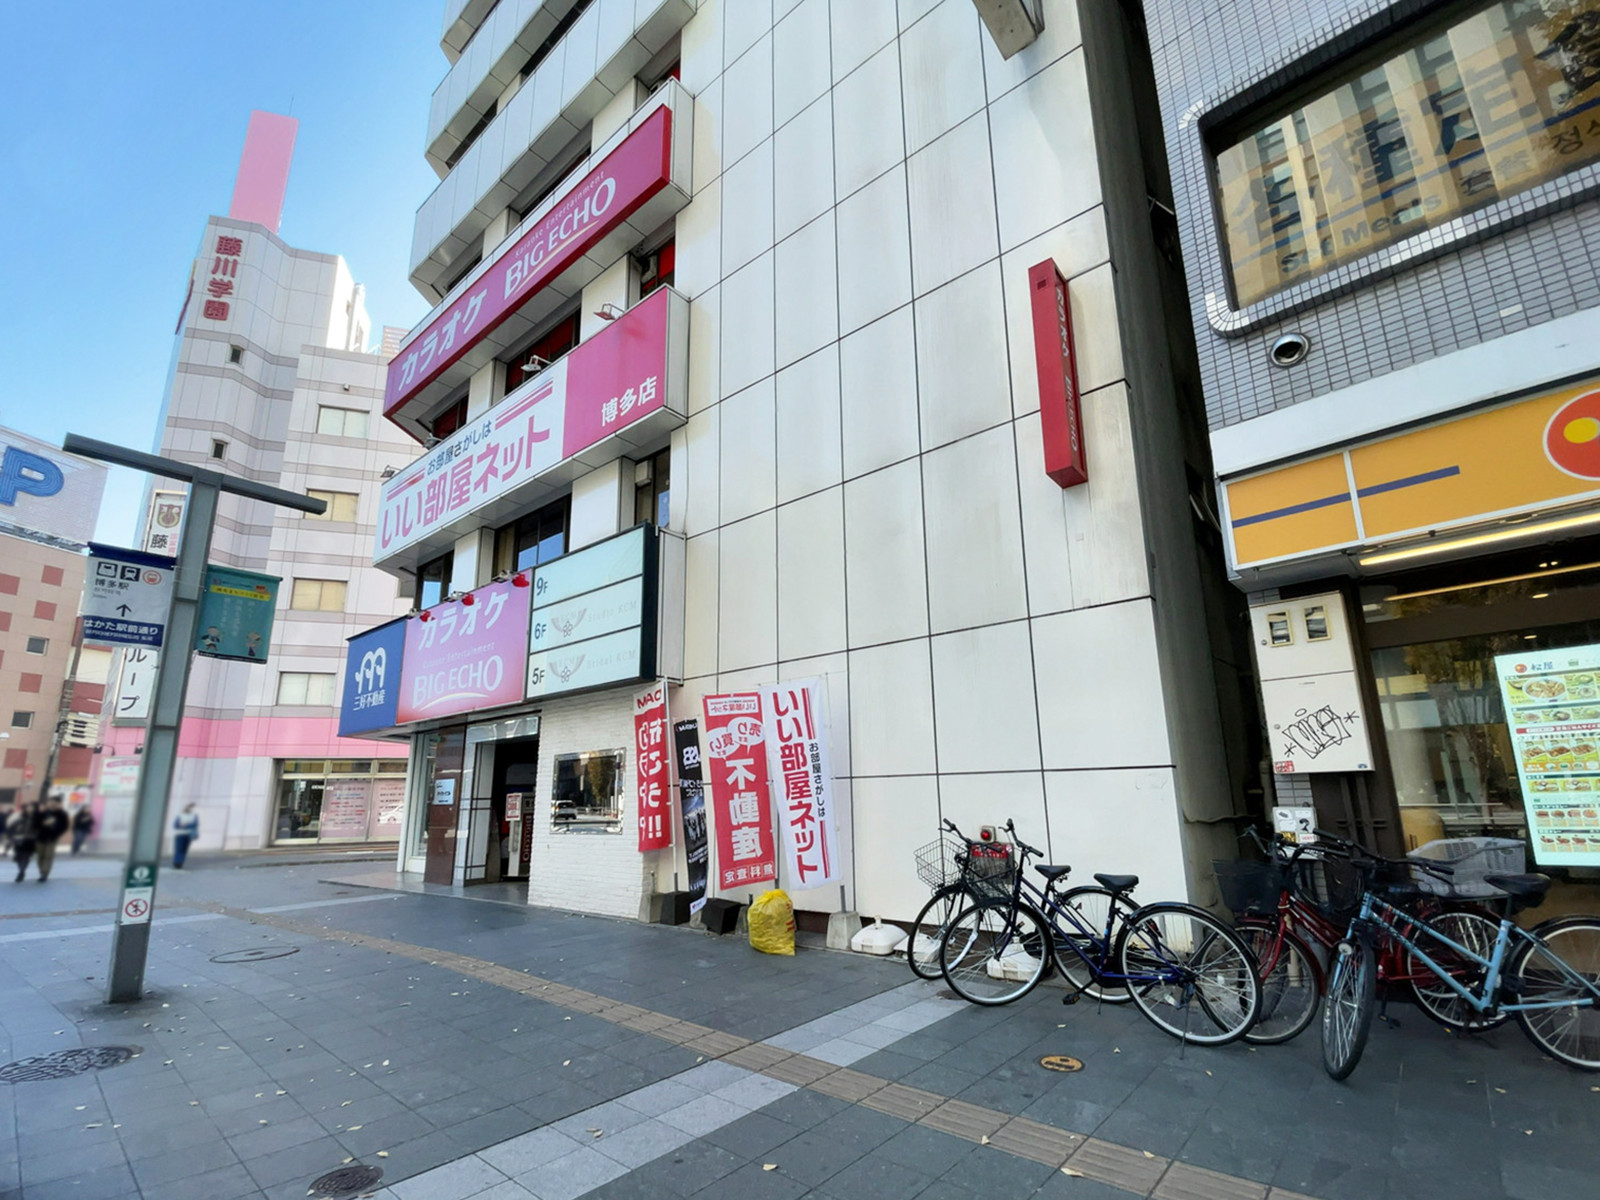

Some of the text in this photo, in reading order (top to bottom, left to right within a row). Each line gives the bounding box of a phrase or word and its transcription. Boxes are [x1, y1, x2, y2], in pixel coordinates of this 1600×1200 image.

[504, 177, 616, 300] BIG ECHO
[399, 288, 488, 392] カラオケ
[601, 376, 657, 427] 博多店
[0, 445, 65, 507] P
[427, 420, 492, 476] お部屋さがしは
[381, 415, 550, 549] いい部屋ネット
[95, 578, 130, 590] 博多駅
[84, 619, 159, 636] はかた駅前通り
[418, 590, 509, 652] カラオケ
[534, 622, 547, 640] 6F
[412, 655, 504, 709] BIG ECHO
[532, 667, 545, 685] 5F
[772, 690, 818, 885] いい部屋ネット
[808, 742, 826, 818] お部屋さがしは
